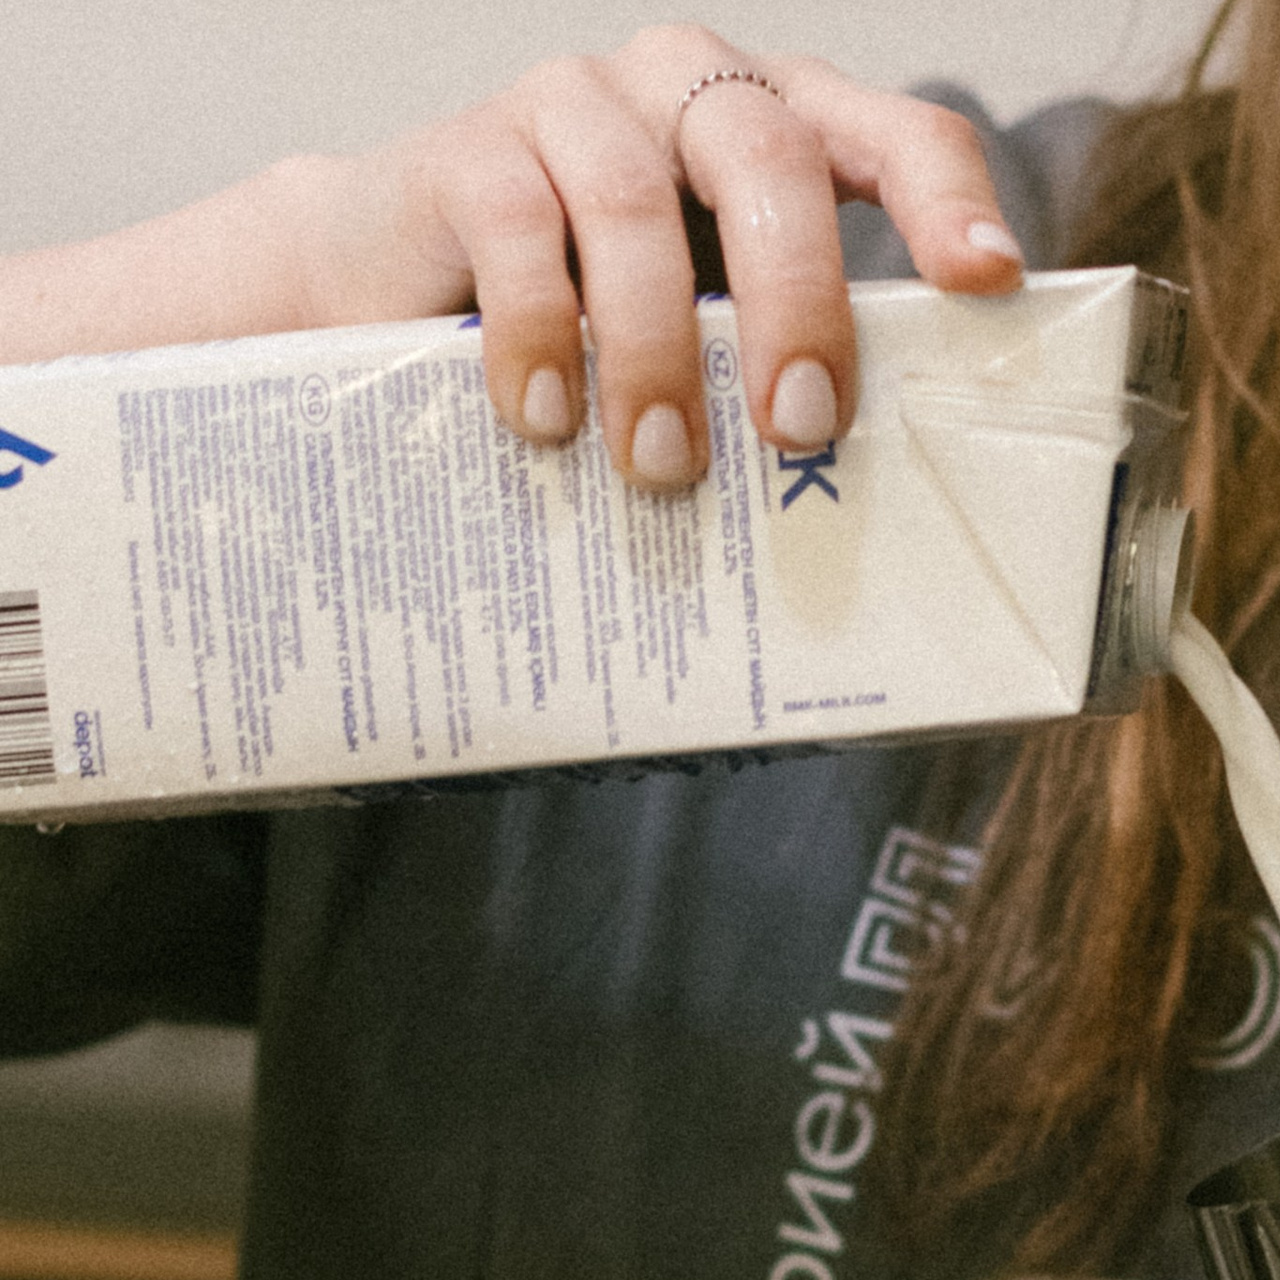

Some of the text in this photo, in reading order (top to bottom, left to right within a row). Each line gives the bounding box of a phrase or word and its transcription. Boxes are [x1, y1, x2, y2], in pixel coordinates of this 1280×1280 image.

[709, 348, 731, 379] KZ
[305, 385, 325, 415] KG
[70, 710, 97, 779] depot
